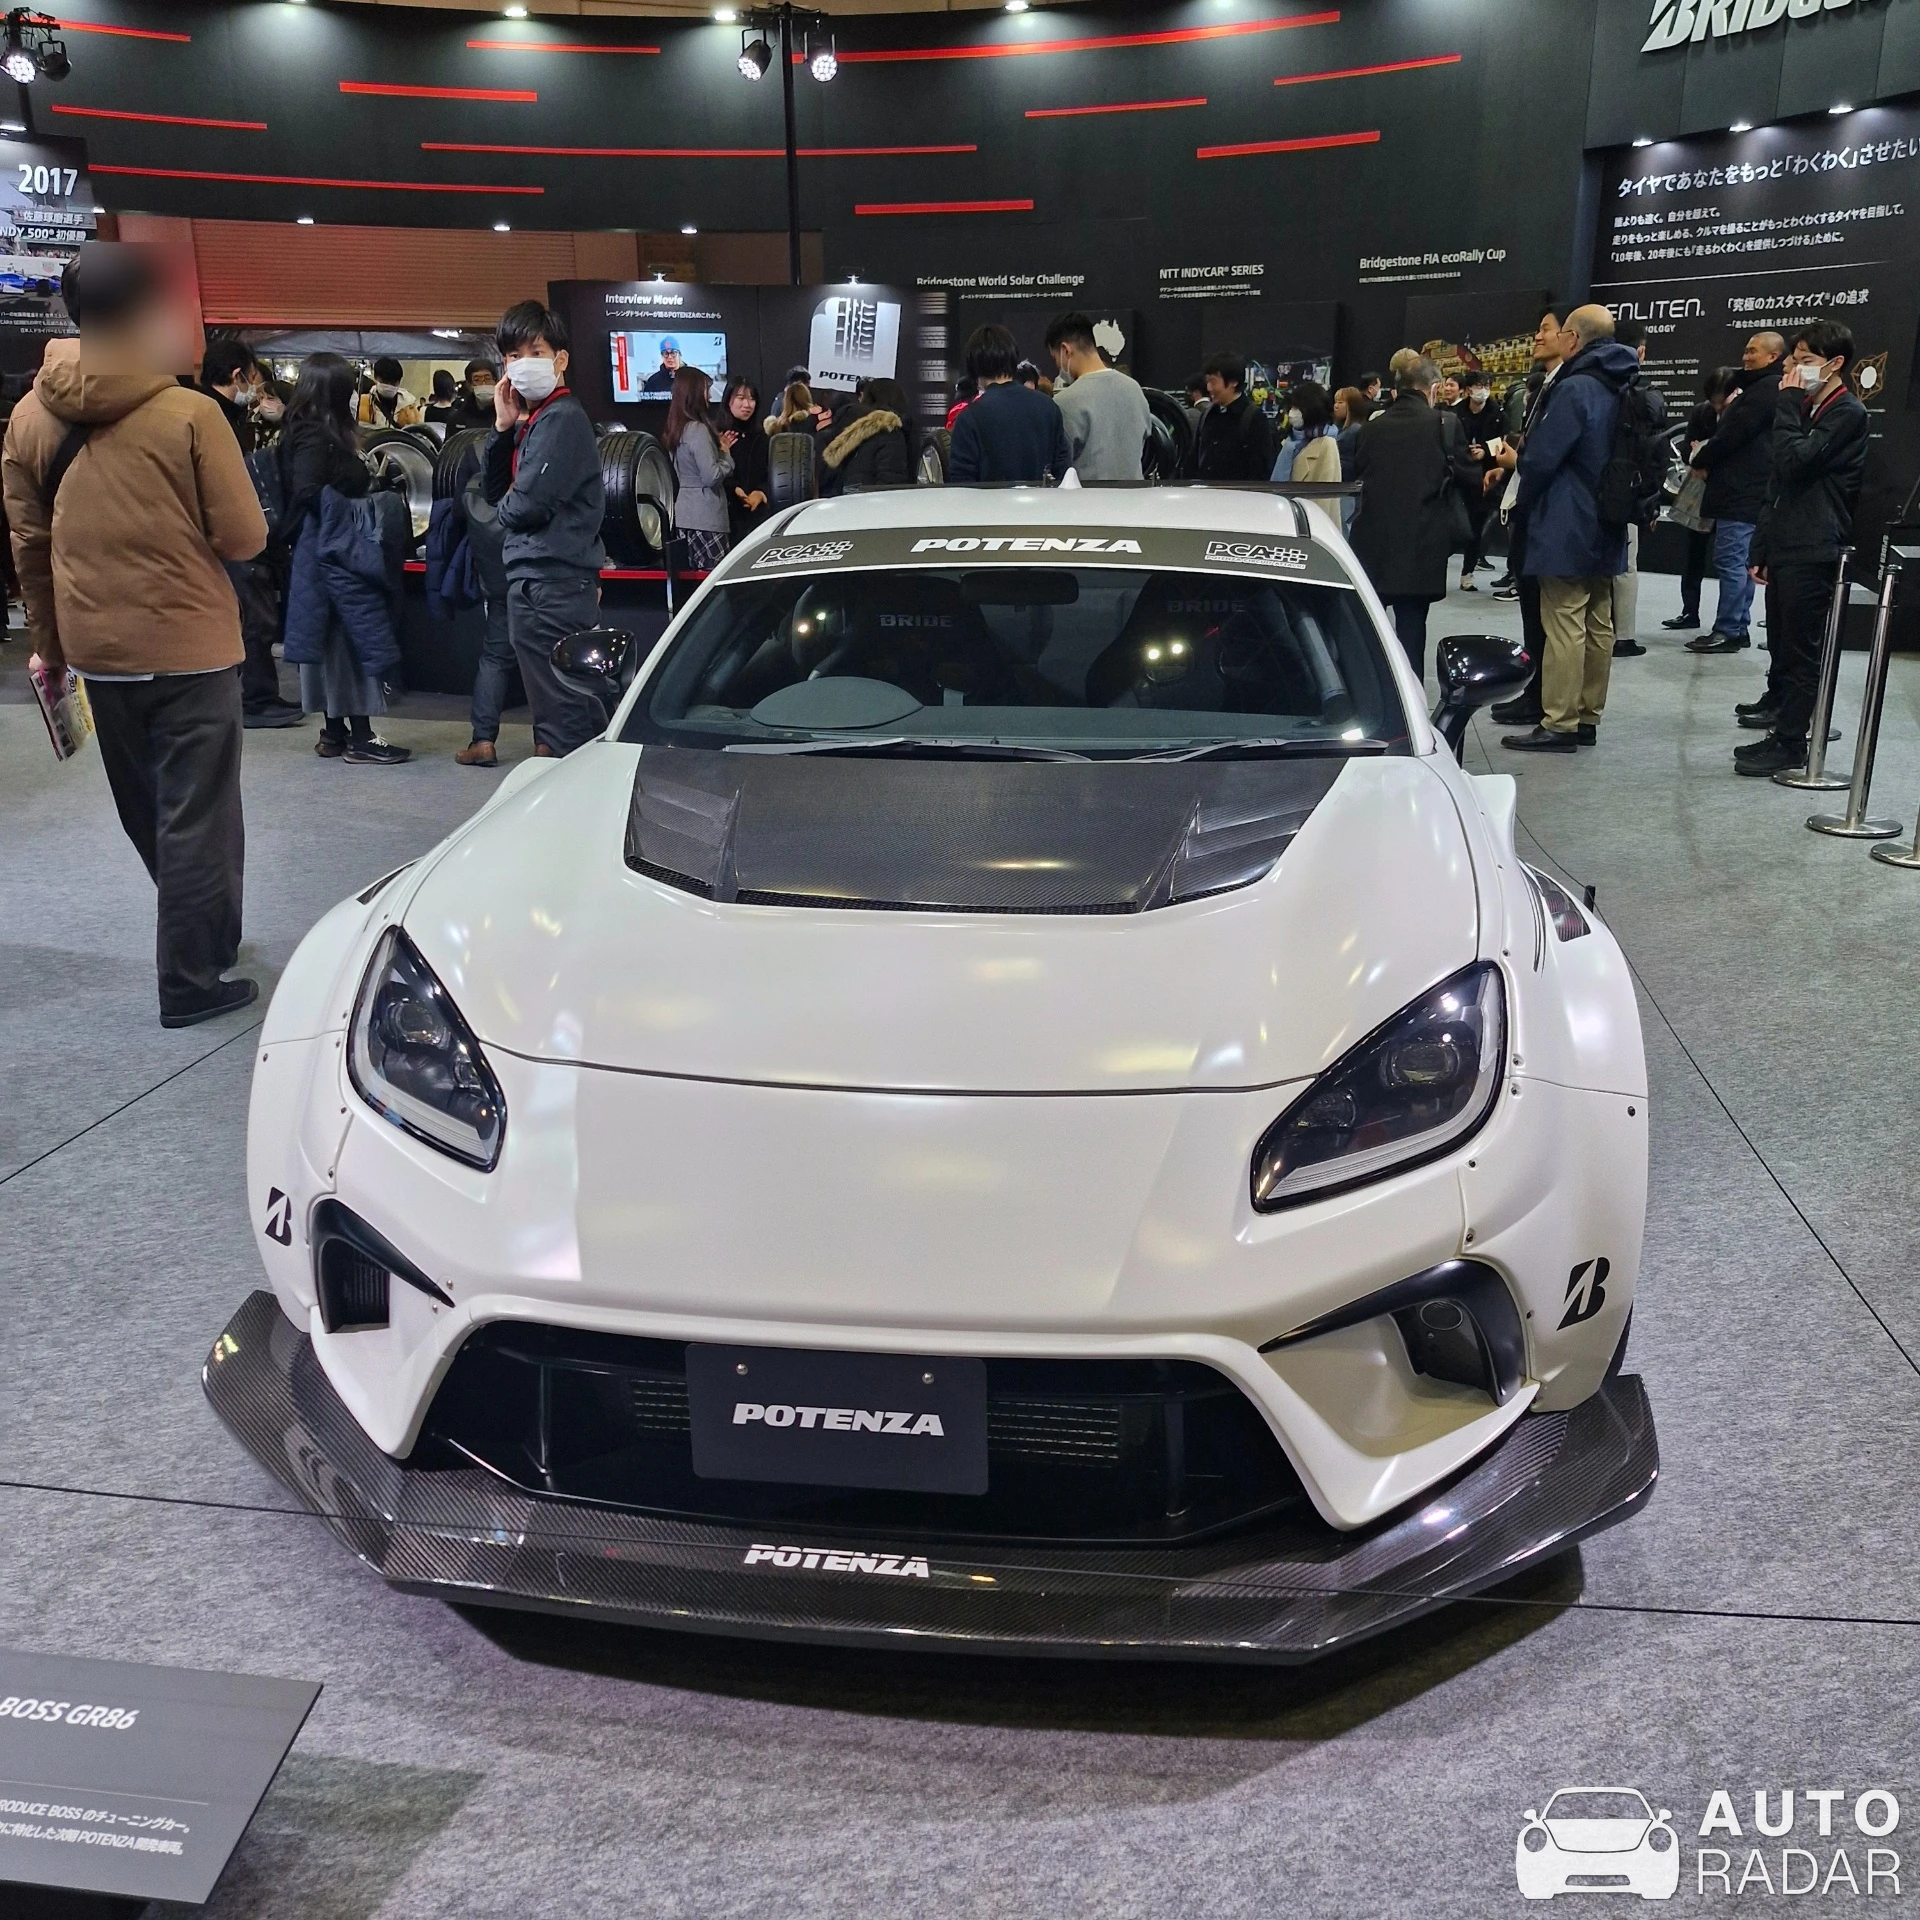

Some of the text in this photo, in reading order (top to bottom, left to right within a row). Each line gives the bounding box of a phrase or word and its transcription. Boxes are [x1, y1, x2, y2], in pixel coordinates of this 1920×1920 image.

[18, 164, 78, 195] 2017
[1359, 248, 1506, 270] Bridgestone FIA ecoRally Cup
[977, 275, 1008, 286] World
[1009, 274, 1035, 286] Solar
[1036, 274, 1085, 286] Challenge
[1159, 268, 1179, 279] NTT
[1231, 264, 1264, 276] SERIES
[605, 293, 684, 306] Interview Movie
[1645, 324, 1677, 334] OLOGY
[755, 543, 824, 564] PCA
[910, 537, 1143, 554] POTENZA
[1206, 541, 1274, 561] PCA
[879, 614, 954, 628] BRIDE
[732, 1403, 945, 1437] POTENZA
[743, 1543, 931, 1578] POTENZA
[0, 1696, 140, 1730] BOSS GR86
[47, 1804, 84, 1820] BOSS
[77, 1830, 135, 1849] POTENZA
